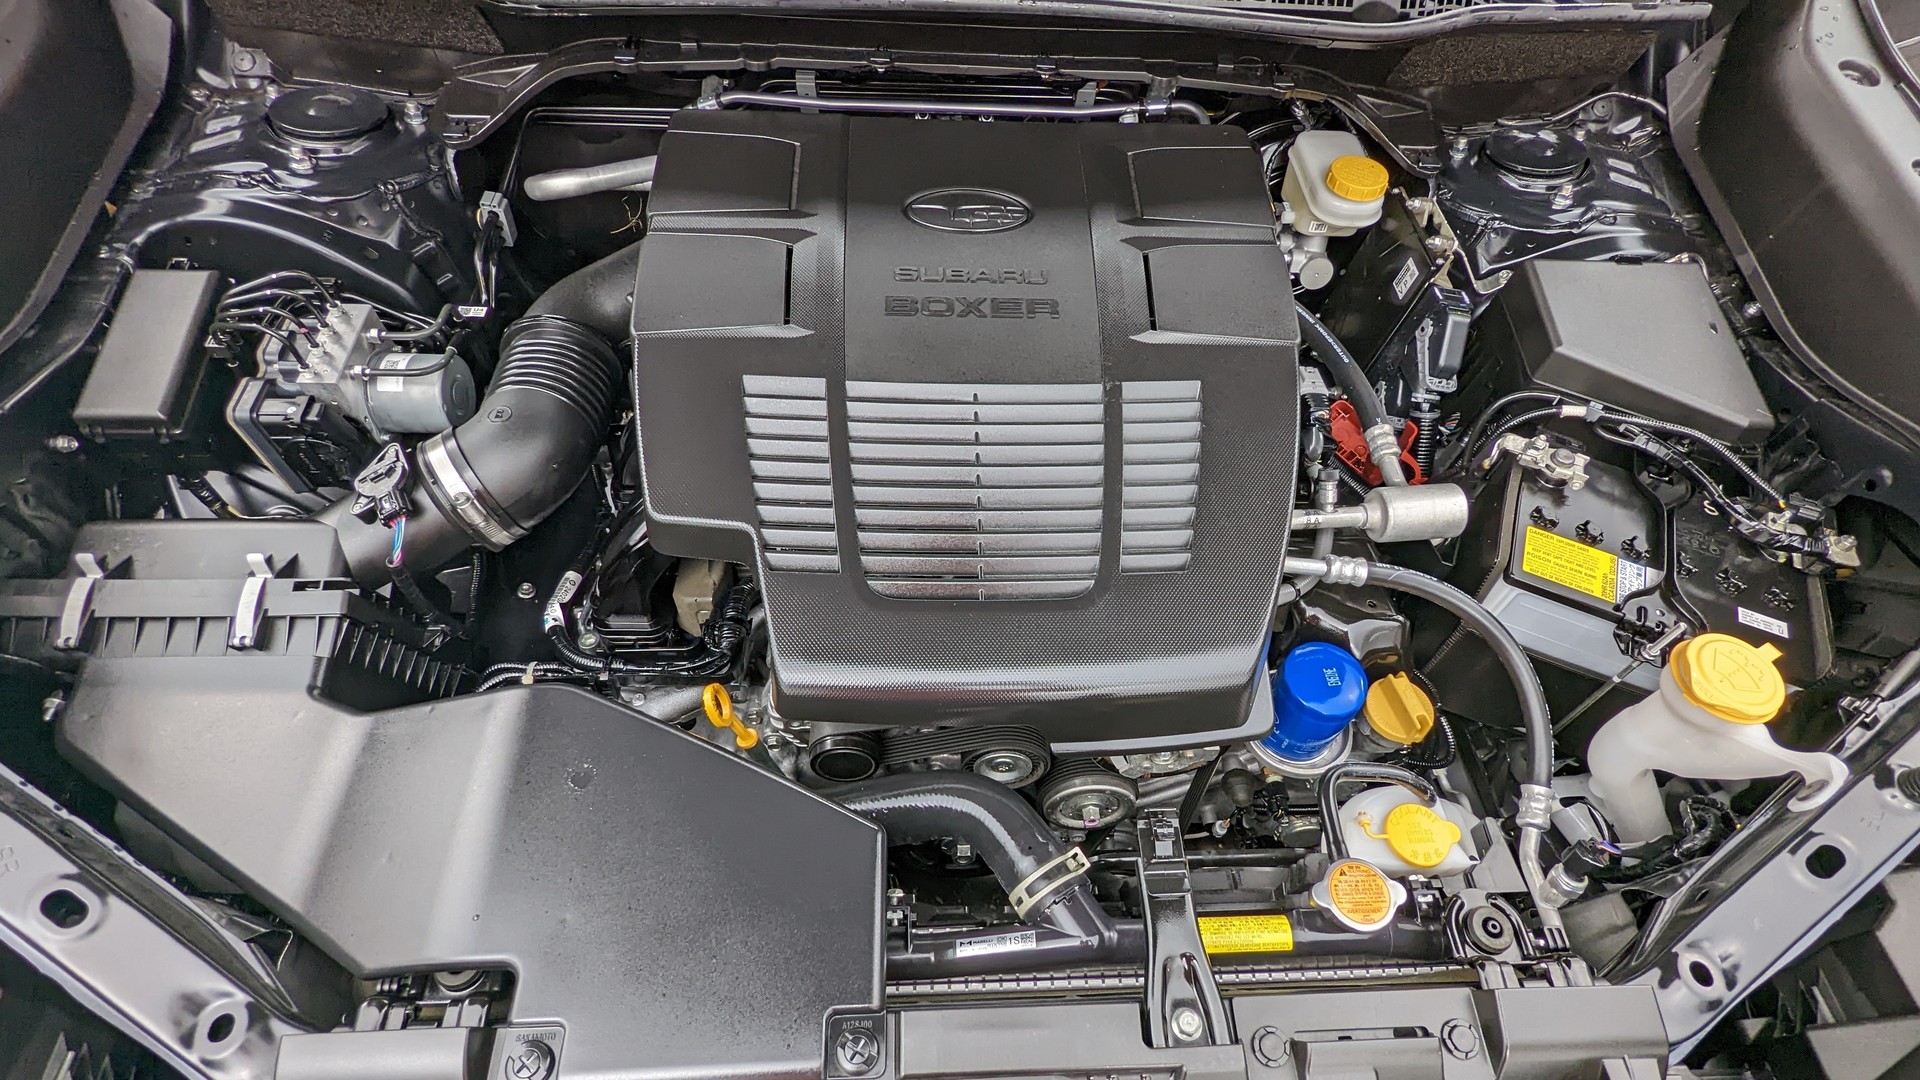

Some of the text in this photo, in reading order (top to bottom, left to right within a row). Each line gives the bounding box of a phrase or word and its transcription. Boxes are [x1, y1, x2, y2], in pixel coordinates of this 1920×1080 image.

[894, 266, 1048, 285] SUBARU
[884, 295, 1060, 319] BOXER
[1529, 528, 1555, 541] DANGER
[1556, 538, 1576, 549] EXPLOSIVE
[1526, 551, 1552, 564] POISON
[1553, 561, 1568, 570] CAUSES
[1569, 566, 1583, 575] SEVERE
[1390, 805, 1442, 827] COOLANT
